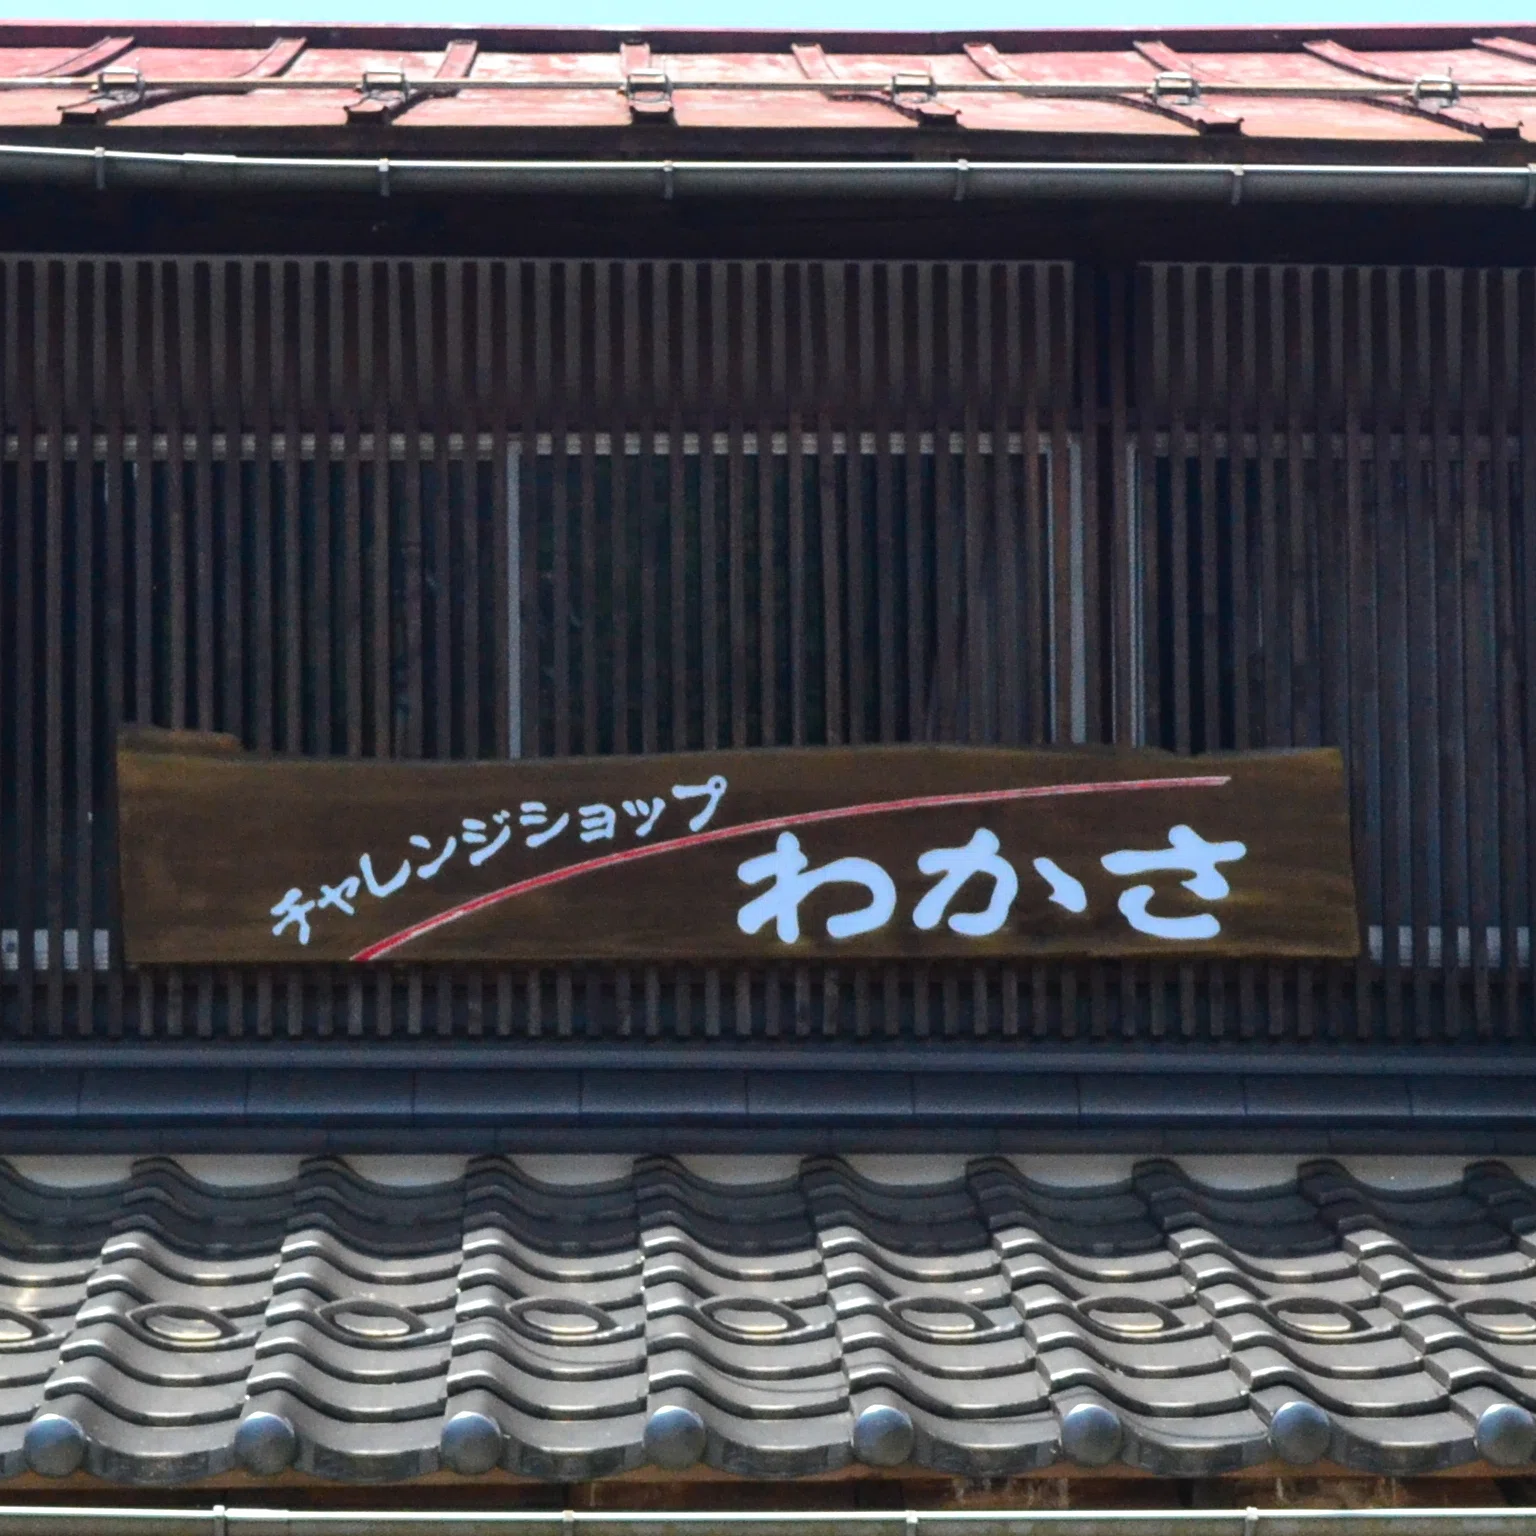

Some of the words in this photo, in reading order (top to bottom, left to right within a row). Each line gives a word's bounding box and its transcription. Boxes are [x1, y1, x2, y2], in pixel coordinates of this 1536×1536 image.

[269, 775, 728, 945] チャレンジショップ
[737, 824, 1247, 944] わかさ
